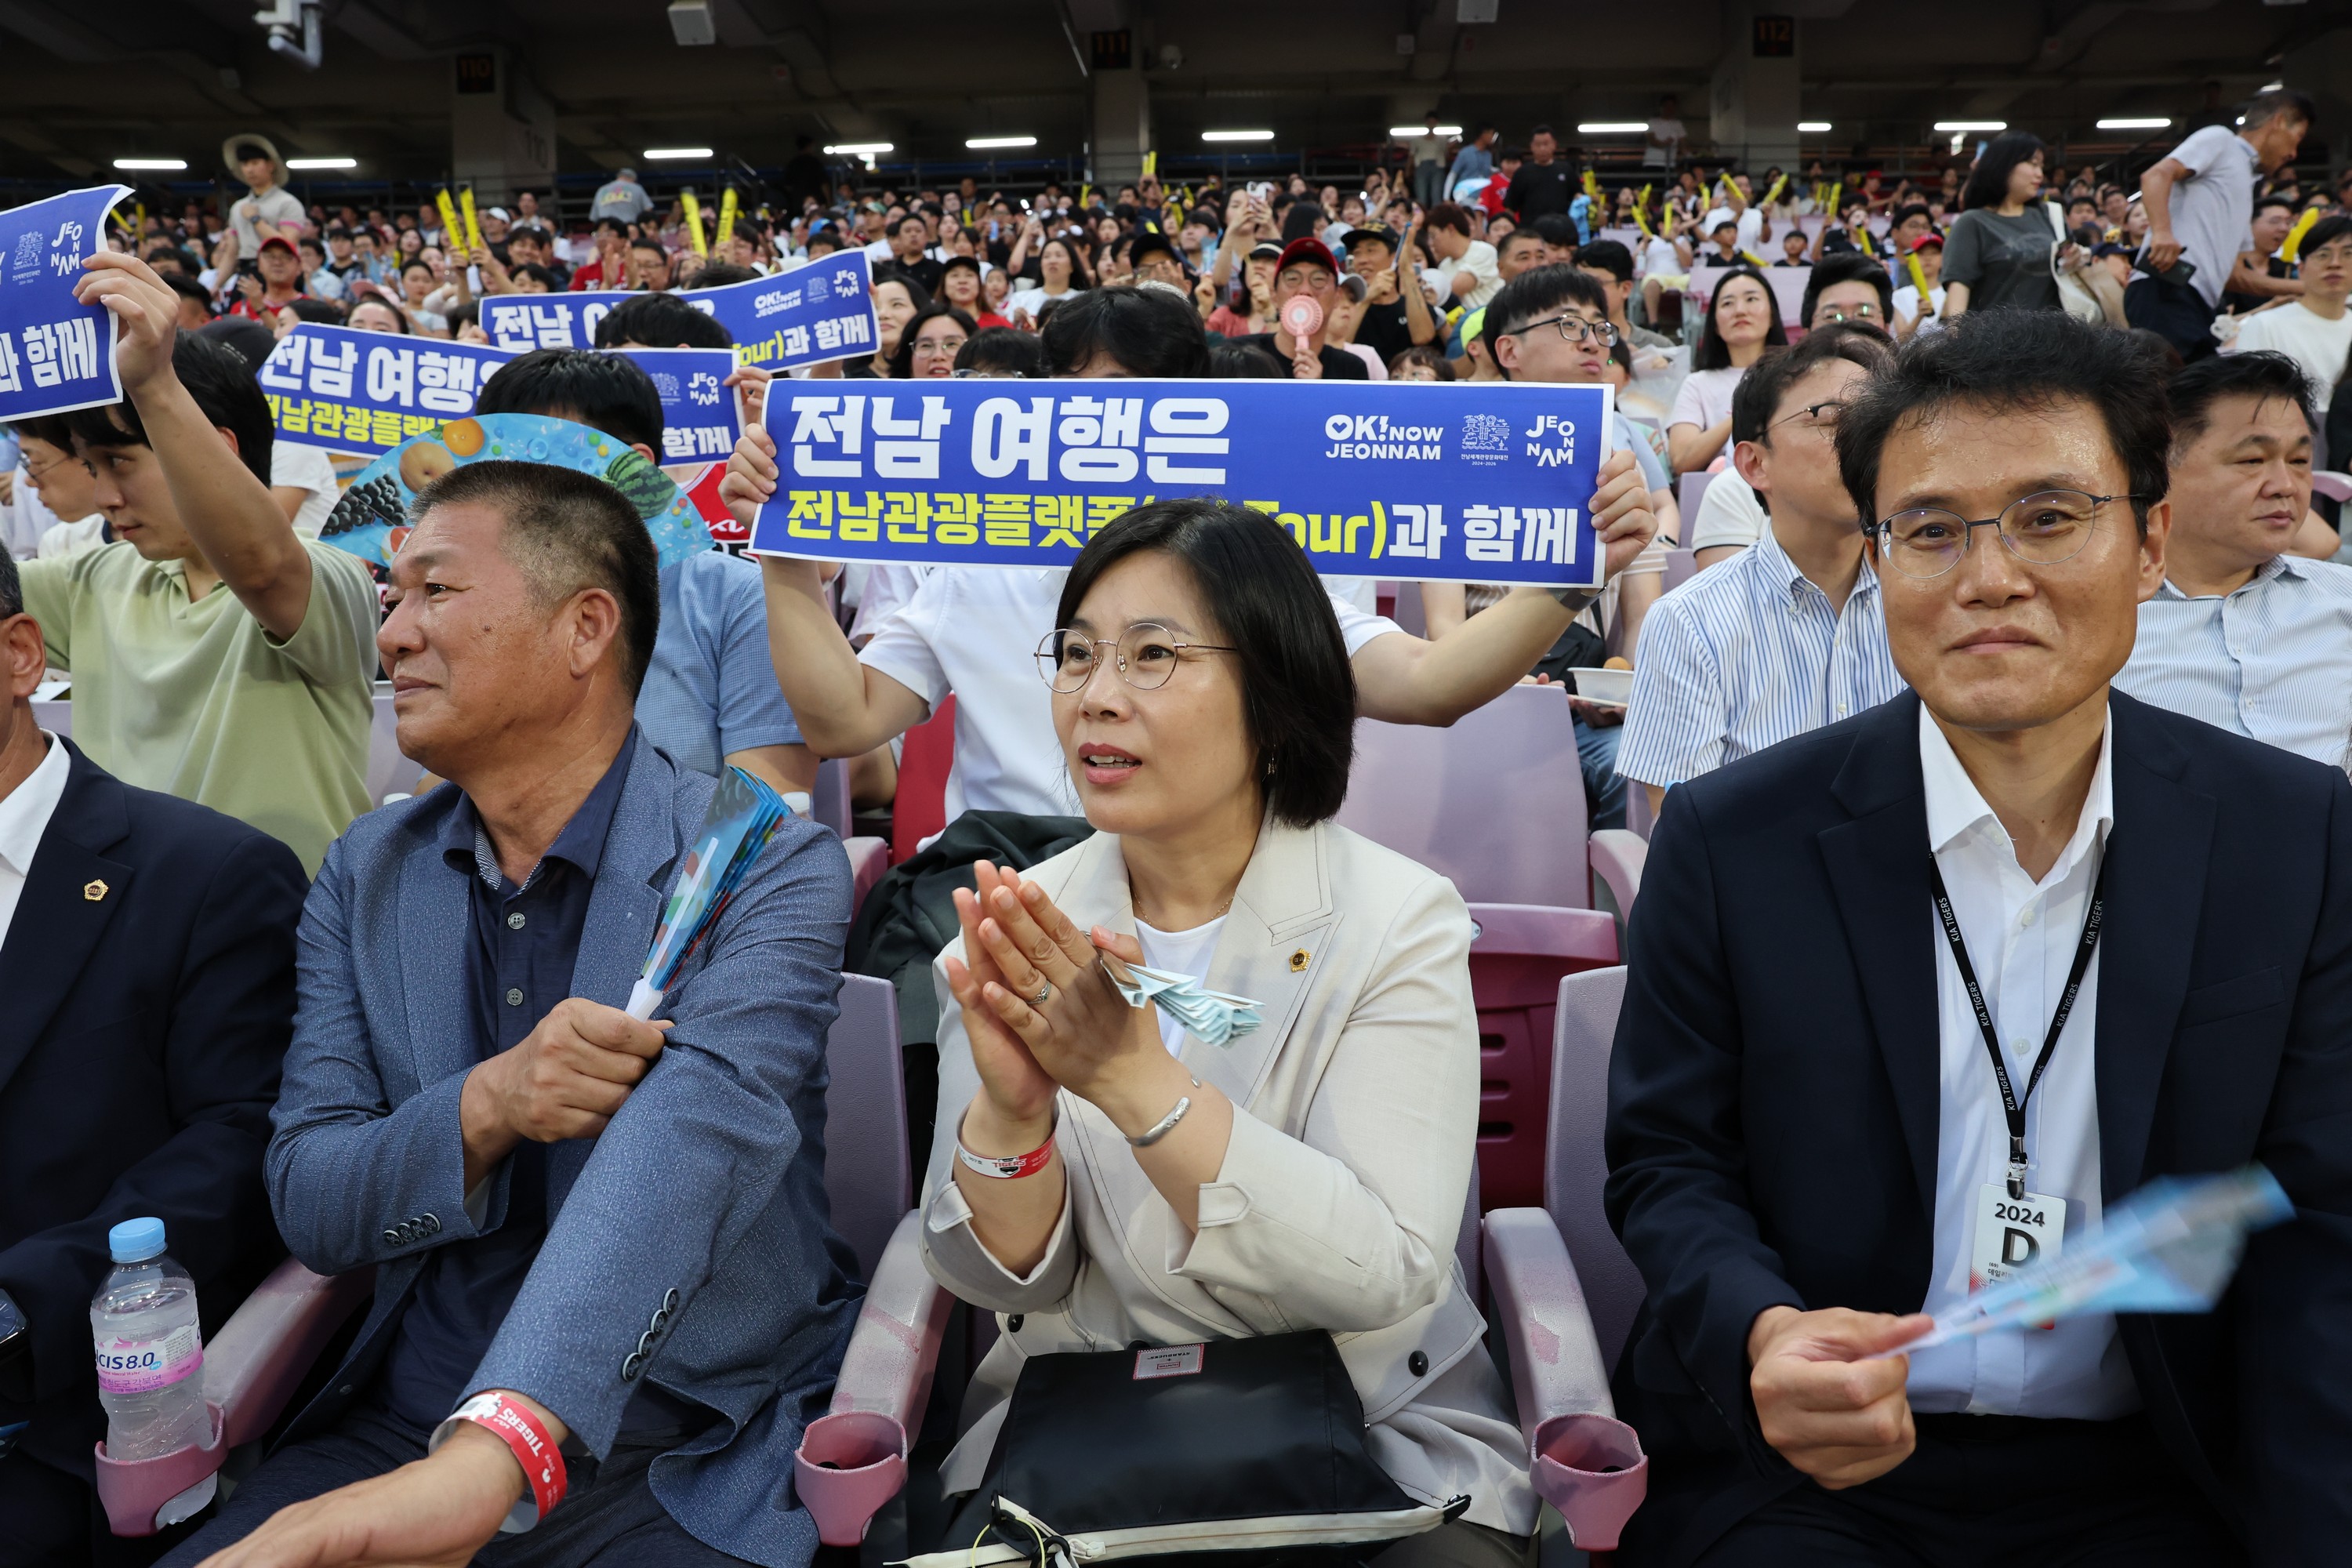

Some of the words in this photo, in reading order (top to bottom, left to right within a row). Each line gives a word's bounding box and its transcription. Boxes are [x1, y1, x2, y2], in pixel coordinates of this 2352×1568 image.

[1094, 34, 1127, 53] 111
[1758, 21, 1790, 42] 112
[459, 58, 491, 78] 110
[756, 298, 802, 318] JEONNAM
[492, 304, 574, 350] 전남
[814, 314, 870, 350] 함께
[23, 317, 98, 388] 함께
[260, 334, 358, 398] 전남
[662, 426, 733, 458] 함께
[790, 396, 952, 479] 전남
[971, 396, 1230, 485] 여행은
[1325, 443, 1441, 460] JEONNAM
[1463, 504, 1578, 564] 함께
[1939, 897, 1955, 927] TIGERS
[2089, 899, 2103, 929] TIGERS
[1949, 927, 1960, 942] KIA
[2085, 929, 2097, 946] KIA
[1968, 981, 1984, 1011] TIGERS
[2056, 1012, 2067, 1028] KIA
[2062, 982, 2078, 1011] TIGERS
[1979, 1011, 1991, 1026] KIA
[1996, 1065, 2010, 1094] TIGERS
[2005, 1096, 2016, 1111] KIA
[992, 1158, 1027, 1168] TIGERS
[1994, 1203, 2045, 1227] 2024
[2002, 1226, 2040, 1268] D
[1987, 1269, 2013, 1279] 데일리
[126, 1352, 155, 1370] 8.0
[1149, 1352, 1190, 1360] STARBUCKS
[500, 1408, 545, 1458] TIGERS
